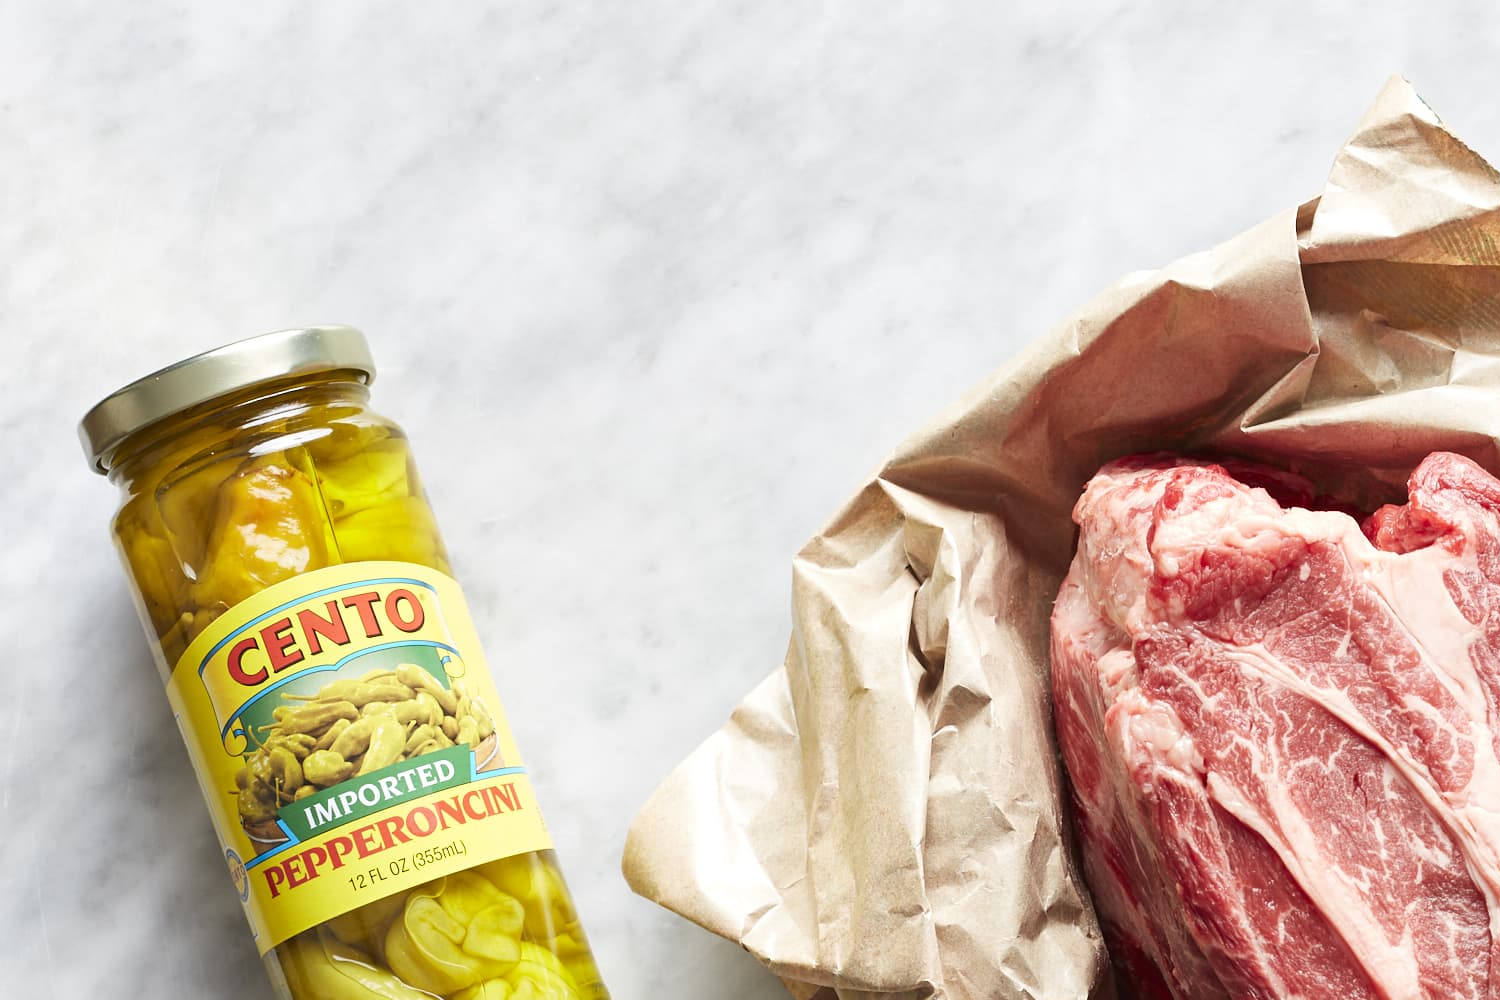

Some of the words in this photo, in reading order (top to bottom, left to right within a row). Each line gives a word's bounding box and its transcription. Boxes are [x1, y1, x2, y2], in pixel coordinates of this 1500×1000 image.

[226, 588, 425, 687] CENTO
[303, 759, 456, 830] IMPORTED
[262, 781, 524, 899] PEPPERONCINI
[349, 874, 365, 892] 12
[368, 866, 388, 884] FL
[389, 857, 411, 877] OZ
[411, 839, 468, 872] (355mL)
